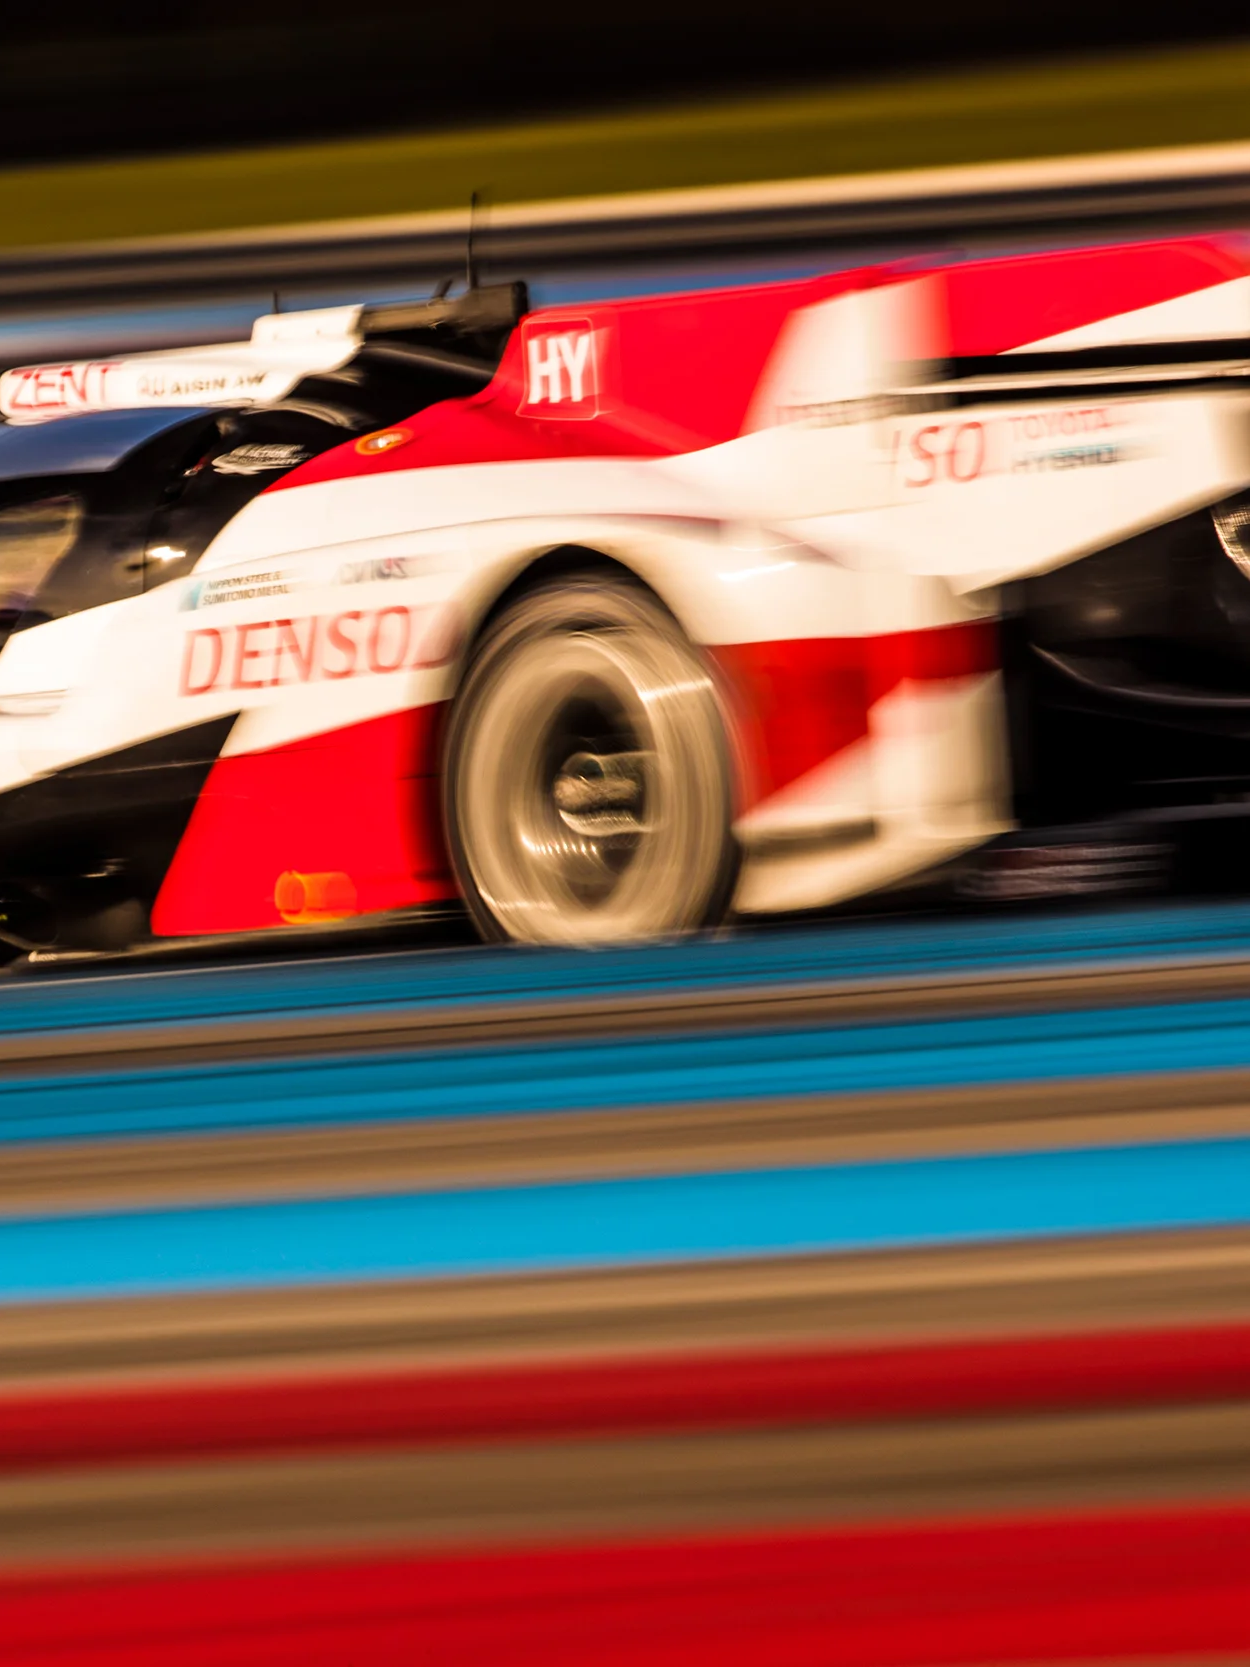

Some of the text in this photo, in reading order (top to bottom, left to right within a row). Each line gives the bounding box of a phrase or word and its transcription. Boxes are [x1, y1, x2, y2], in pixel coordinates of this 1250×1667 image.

[9, 362, 121, 410] ZENT
[527, 334, 590, 404] HY
[178, 605, 412, 697] DENSO
